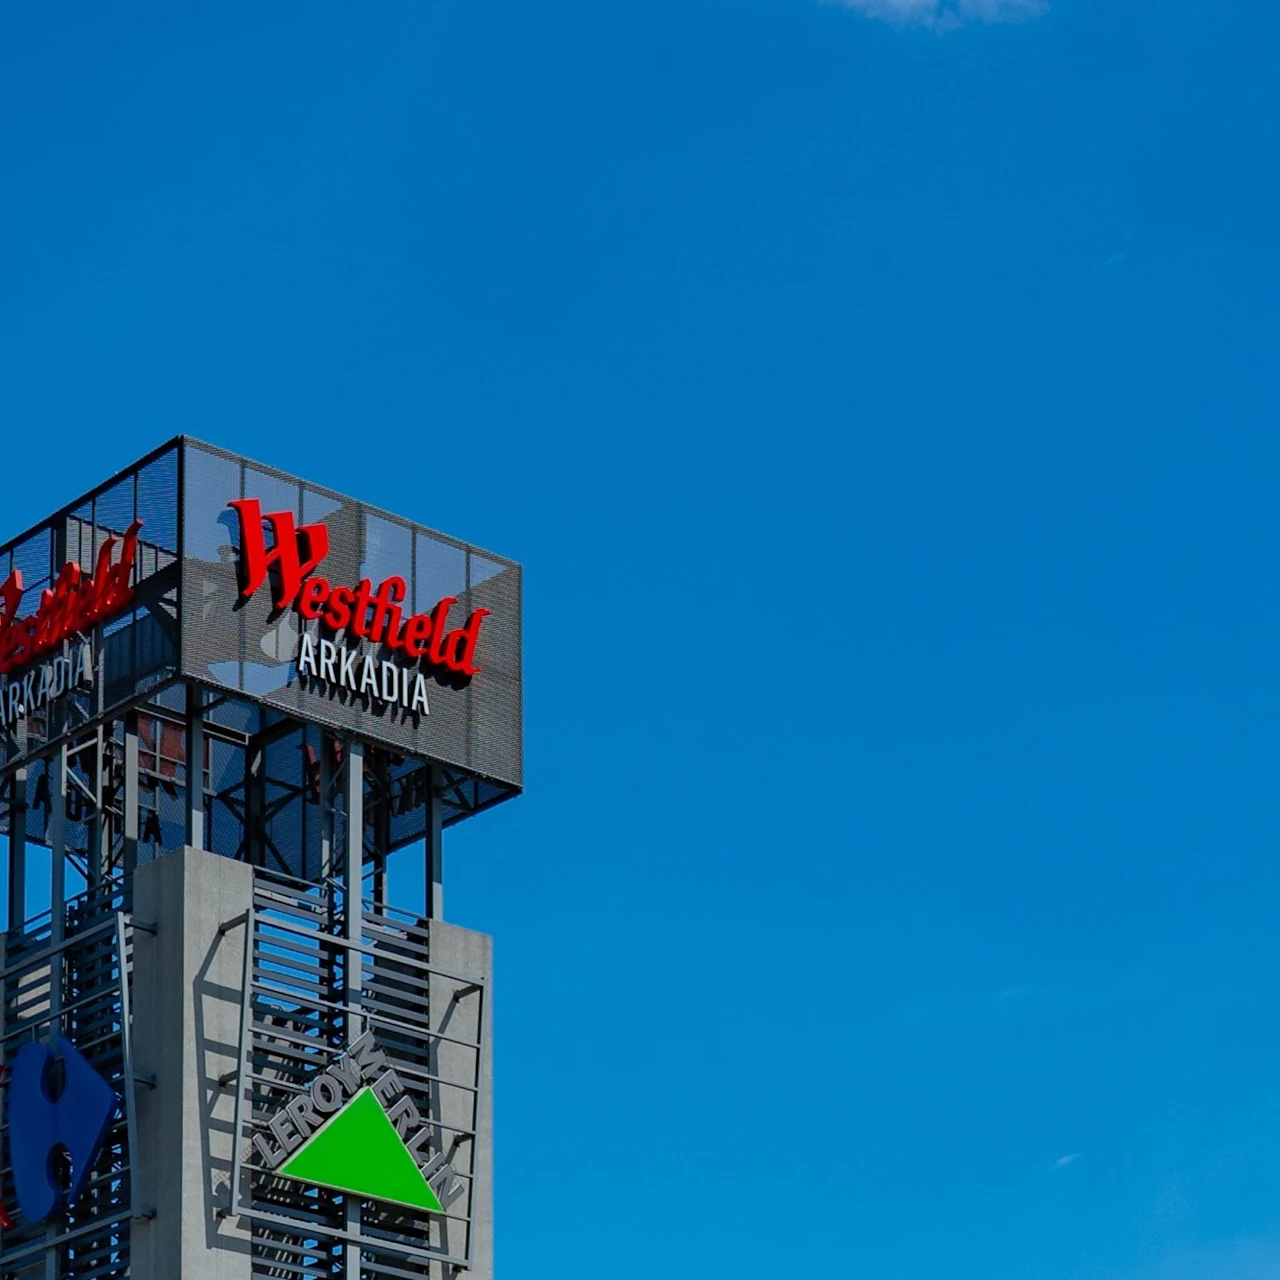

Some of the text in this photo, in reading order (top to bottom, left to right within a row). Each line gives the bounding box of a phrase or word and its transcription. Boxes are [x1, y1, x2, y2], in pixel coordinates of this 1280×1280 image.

[228, 497, 490, 676] Westfield
[298, 633, 430, 716] ARKADIA
[252, 1030, 465, 1211] LEROY MERLIN
